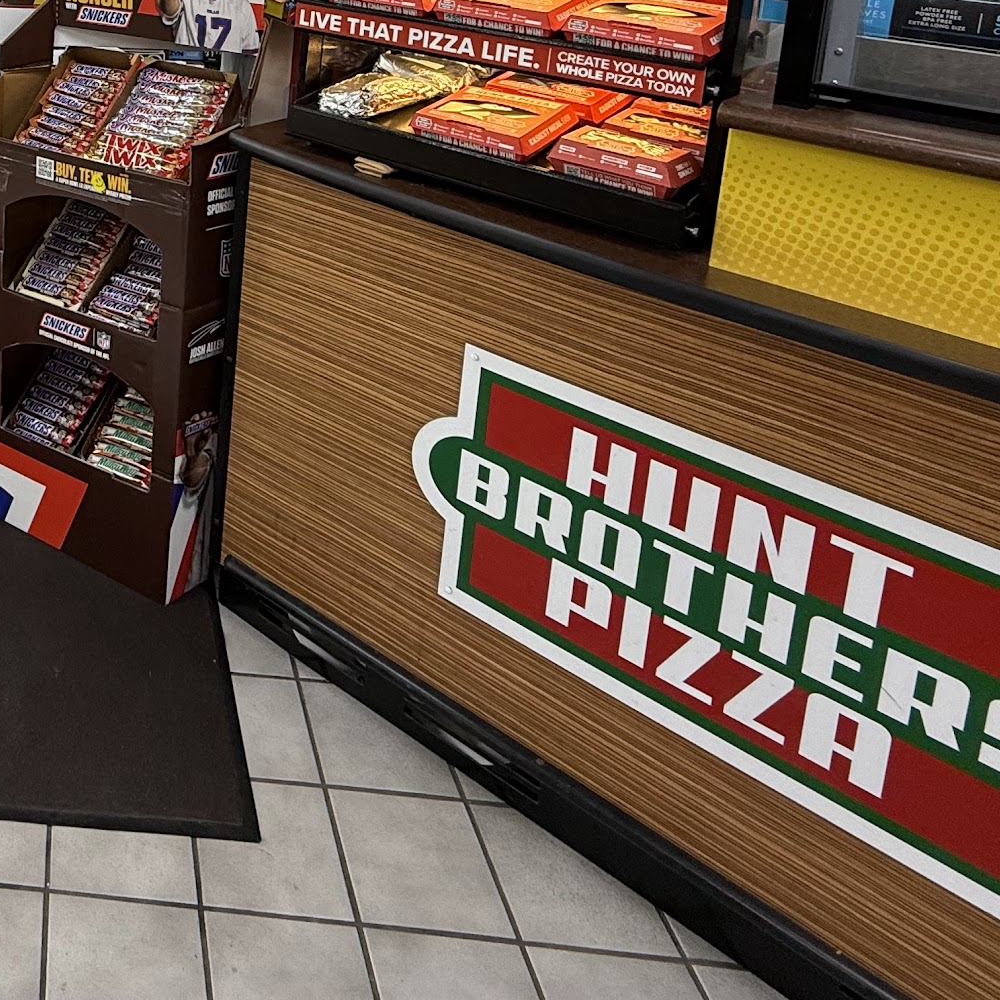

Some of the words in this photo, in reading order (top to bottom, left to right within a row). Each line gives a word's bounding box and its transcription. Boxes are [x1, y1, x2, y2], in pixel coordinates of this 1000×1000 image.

[80, 8, 129, 25] SNICKERS
[463, 17, 476, 26] FOR
[484, 19, 513, 32] CHANCE
[515, 24, 525, 34] TO
[526, 26, 543, 36] WIN!
[195, 13, 233, 50] 17
[299, 9, 342, 32] LIVE
[347, 16, 403, 43] THAT
[408, 27, 475, 57] PIZZA
[482, 40, 539, 69] LIFE.
[595, 38, 612, 49] FOR
[614, 41, 619, 49] A
[621, 42, 657, 56] CHANCE
[659, 49, 671, 58] TO
[673, 51, 694, 61] WIN!
[556, 63, 603, 81] WHOLE
[605, 73, 643, 89] PIZZA
[646, 79, 694, 98] TODAY
[557, 51, 610, 70] CREATE
[613, 60, 653, 80] YOUR
[656, 69, 696, 86] OWN
[105, 133, 161, 154] TWIX
[103, 146, 157, 168] TWIX
[55, 161, 78, 181] BUY.
[107, 173, 131, 194] WIN.
[25, 276, 61, 295] SNICKERS
[43, 315, 88, 339] SNICKERS
[190, 344, 206, 359] JOSH
[16, 412, 52, 436] SNICKERS
[566, 427, 914, 627] HUNT
[544, 558, 893, 799] PIZZA
